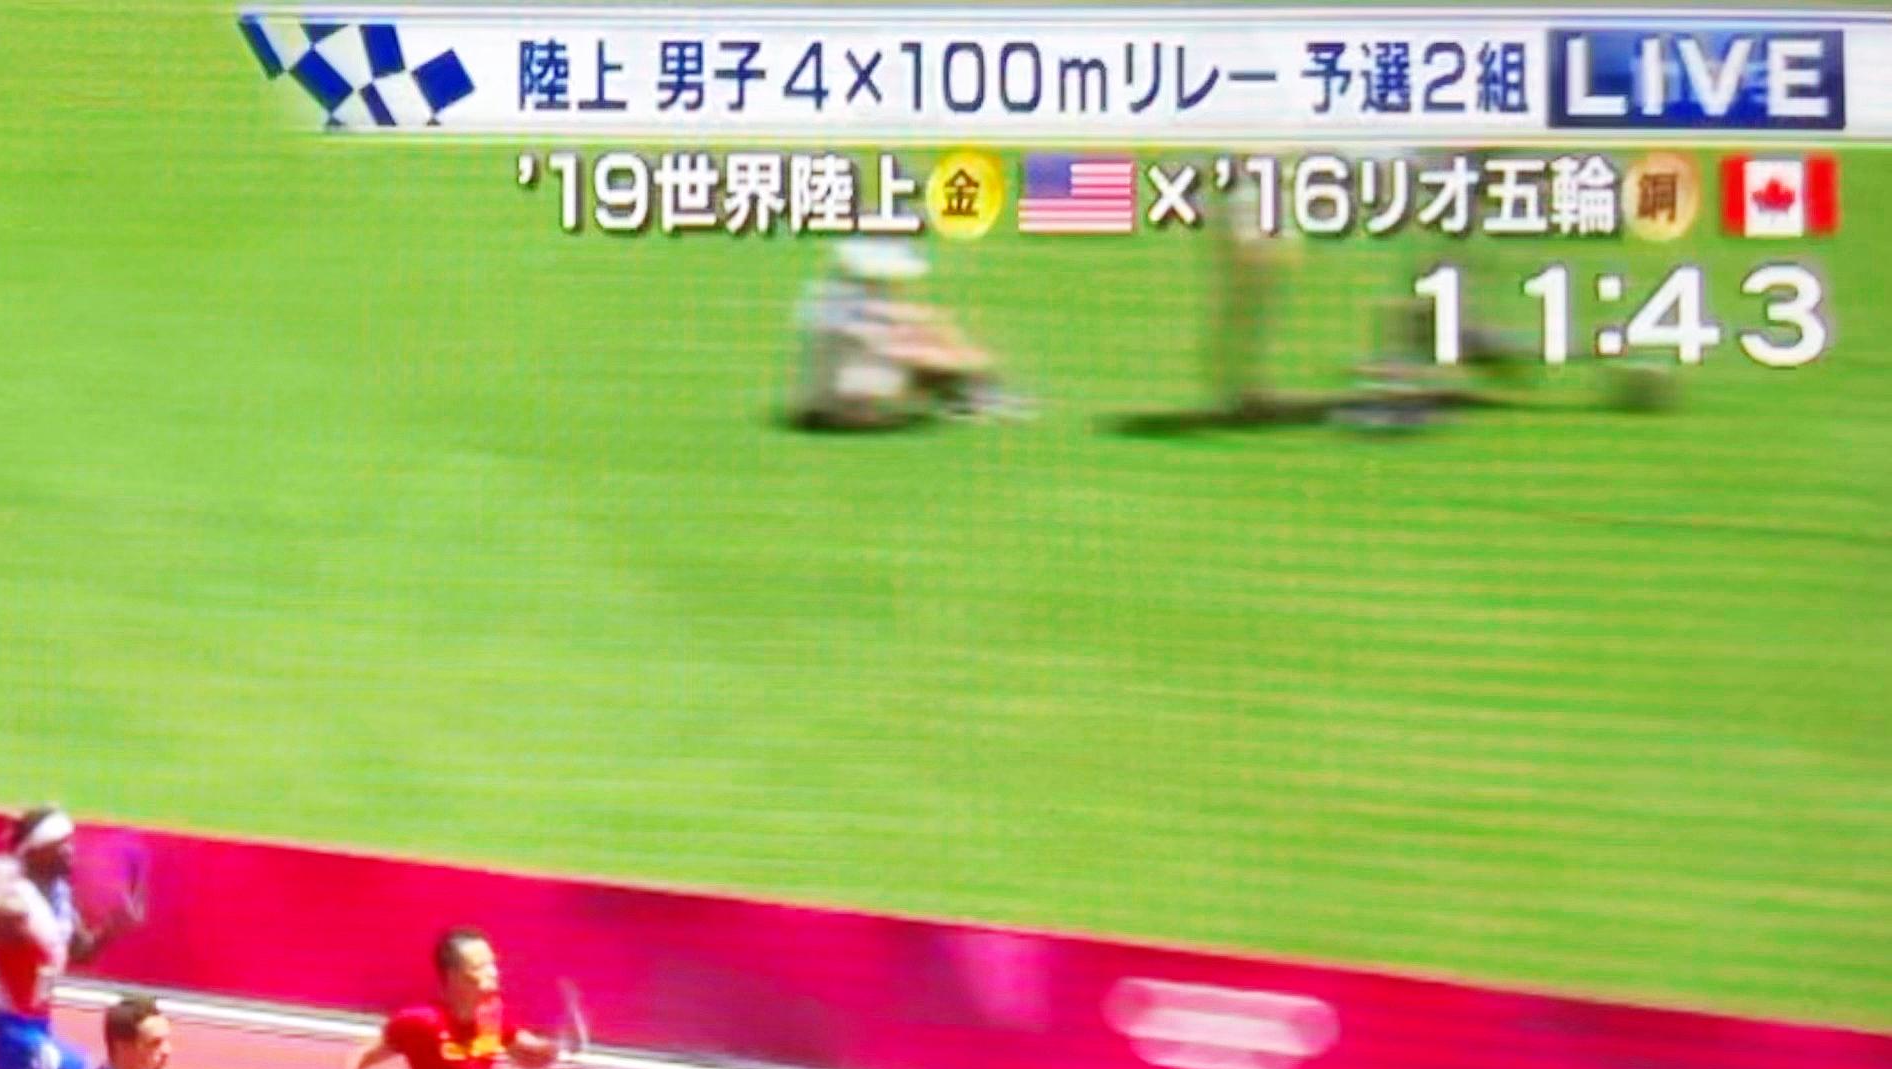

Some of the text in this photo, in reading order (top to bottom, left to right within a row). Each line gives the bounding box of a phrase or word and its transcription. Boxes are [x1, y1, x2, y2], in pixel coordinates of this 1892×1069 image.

[518, 40, 628, 112] 陸上
[1300, 40, 1530, 114] 予選2組
[1566, 36, 1830, 117] LIVE
[1414, 262, 1828, 368] 11:43
